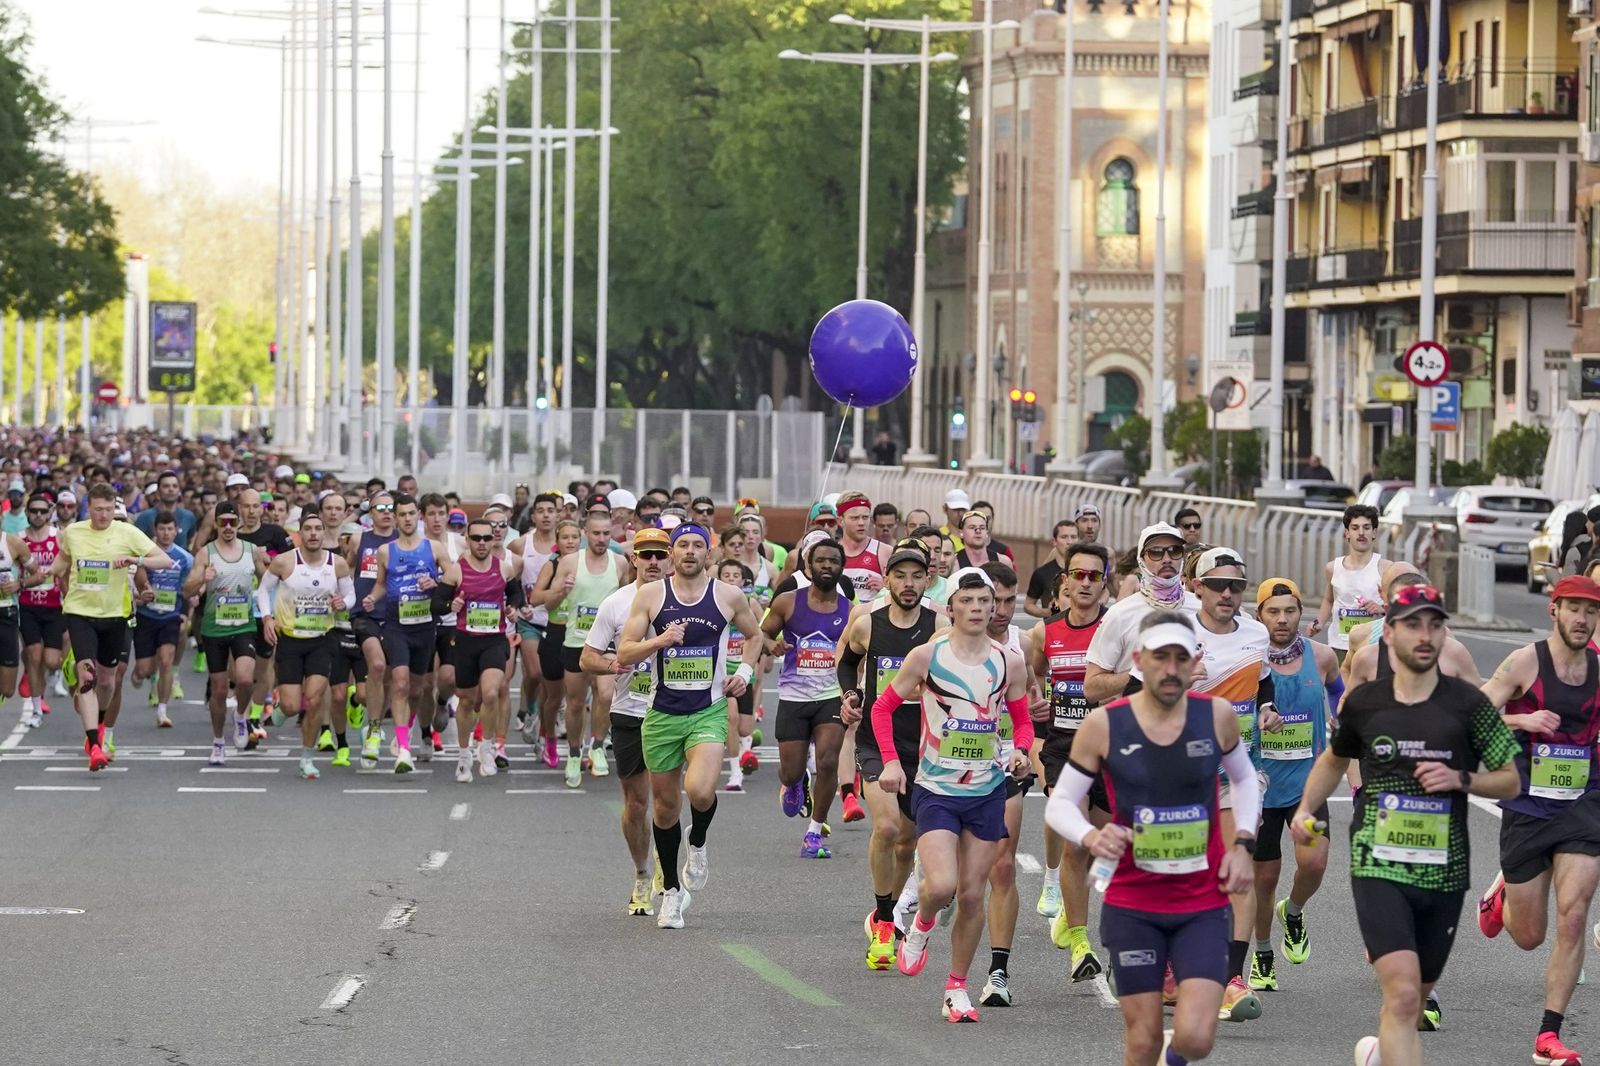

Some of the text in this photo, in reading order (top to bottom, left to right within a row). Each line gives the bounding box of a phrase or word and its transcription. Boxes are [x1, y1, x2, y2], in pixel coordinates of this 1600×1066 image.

[1431, 387, 1451, 414] P
[662, 617, 719, 632] LONG EATON R.C.
[811, 641, 833, 649] ZURICH
[680, 648, 707, 656] ZURICH
[800, 660, 834, 668] ANTHONY
[667, 670, 709, 680] MARTINO
[1070, 698, 1087, 706] 3575
[961, 722, 992, 731] ZURICH
[962, 737, 977, 745] 1871
[1261, 740, 1312, 750] VITOR PARADA
[951, 746, 983, 758] PETER
[1553, 747, 1585, 756] ZURICH
[1554, 764, 1572, 772] 1657
[1550, 774, 1573, 787] ROB
[1402, 799, 1444, 811] ZURICH
[1158, 807, 1200, 821] ZURICH
[1161, 831, 1184, 841] 1913
[1386, 831, 1437, 847] ADRIEN
[1134, 847, 1160, 858] CRIS
[1163, 848, 1170, 858] Y
